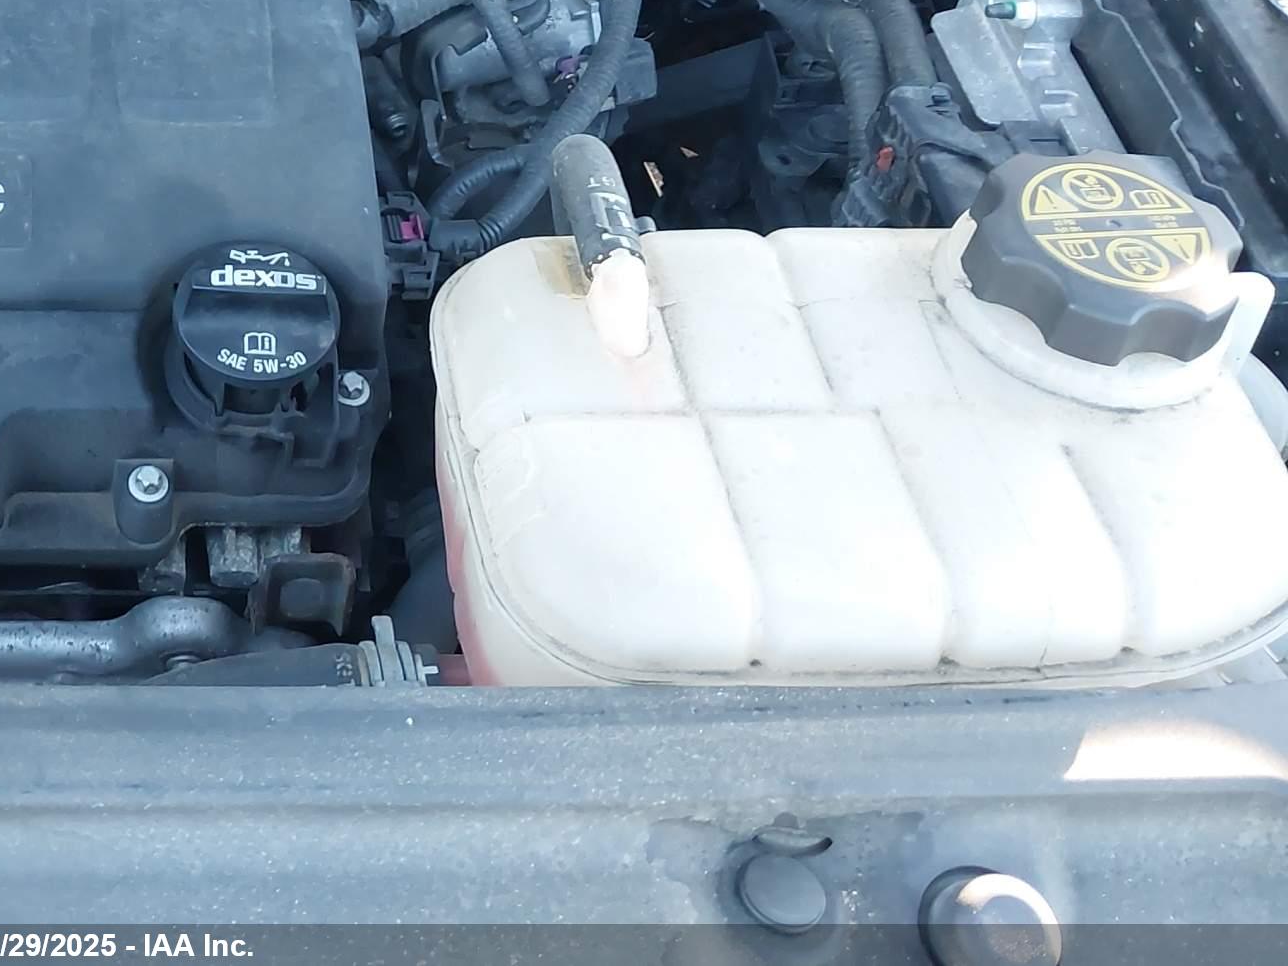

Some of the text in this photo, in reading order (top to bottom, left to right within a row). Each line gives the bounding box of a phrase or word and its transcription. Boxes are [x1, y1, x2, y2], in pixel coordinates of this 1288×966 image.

[210, 264, 317, 291] dexos
[216, 348, 307, 373] SAE 5W-30
